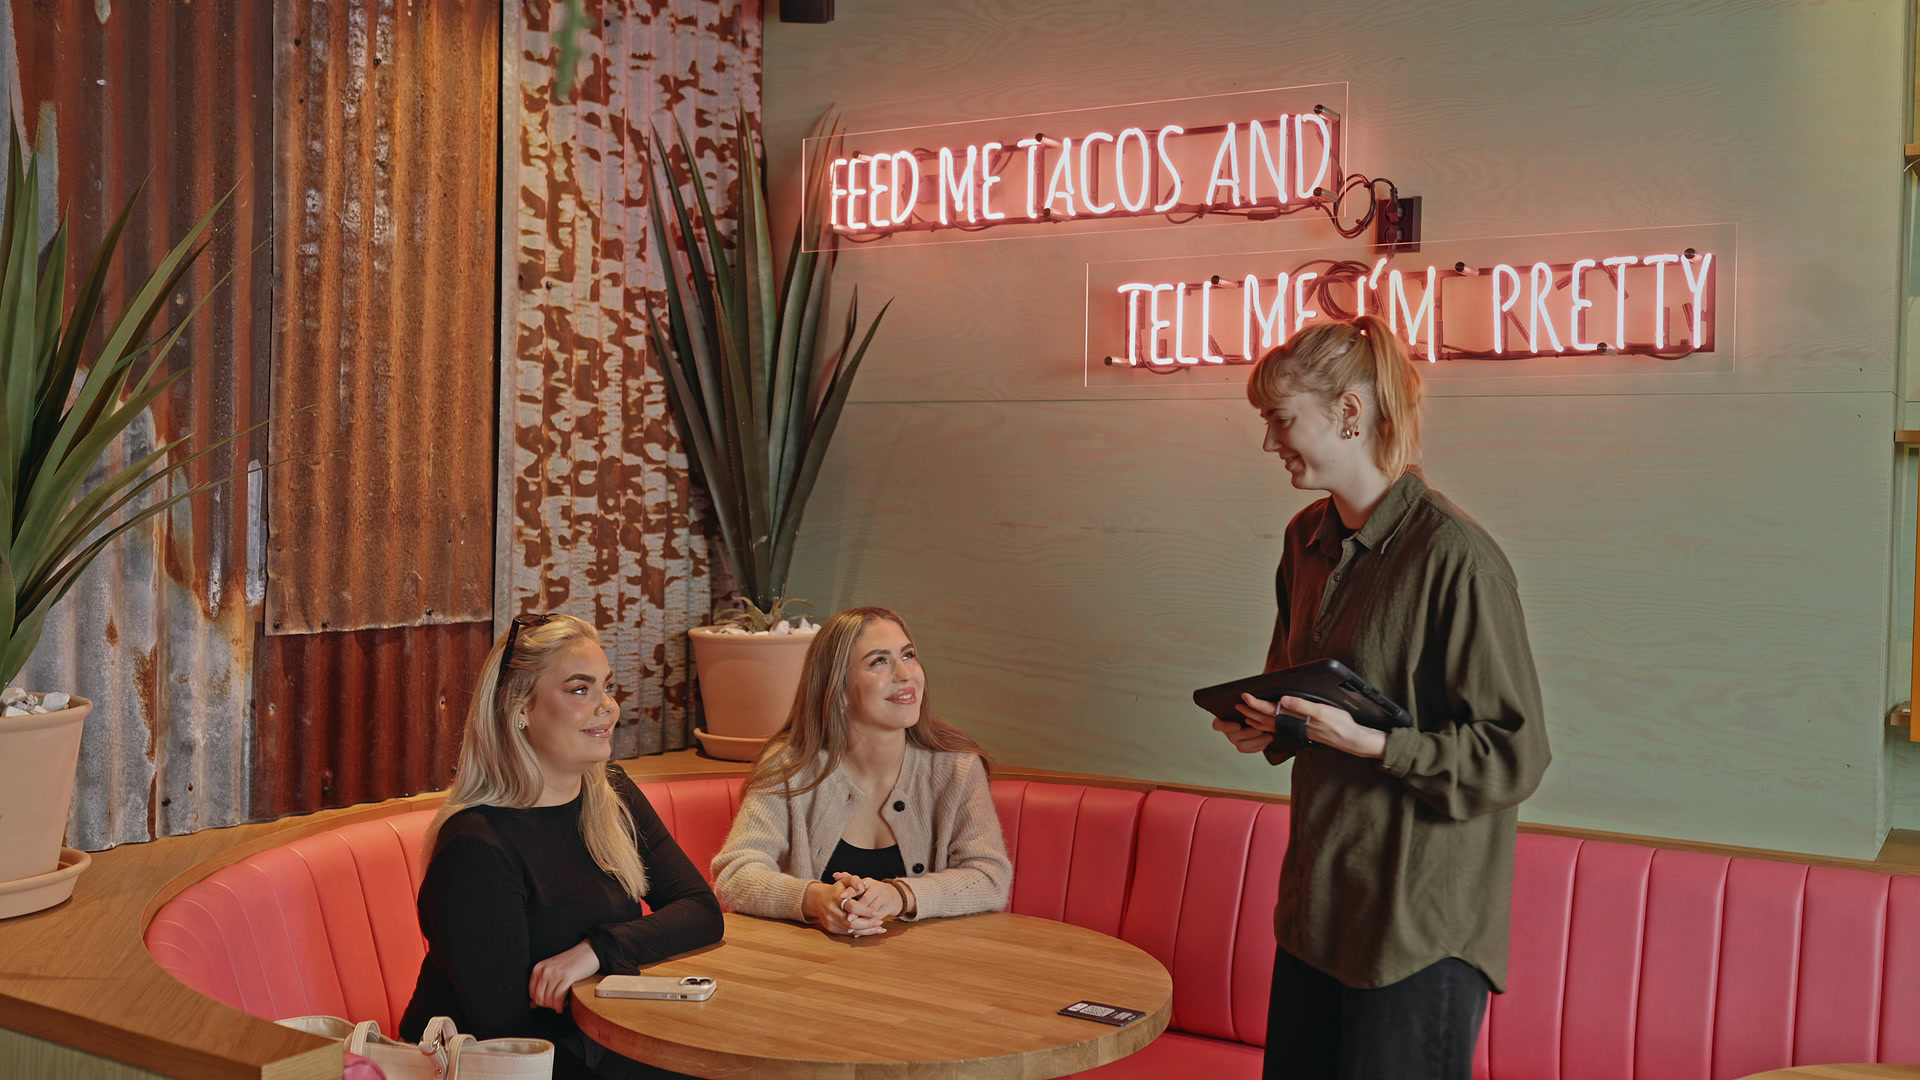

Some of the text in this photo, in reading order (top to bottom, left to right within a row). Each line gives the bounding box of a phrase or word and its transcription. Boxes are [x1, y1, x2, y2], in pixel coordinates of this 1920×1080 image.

[829, 113, 1330, 229] FEED ME TACOS AND
[1117, 282, 1224, 366] TELL
[1243, 271, 1318, 361] ME
[1493, 253, 1713, 354] PRETTY
